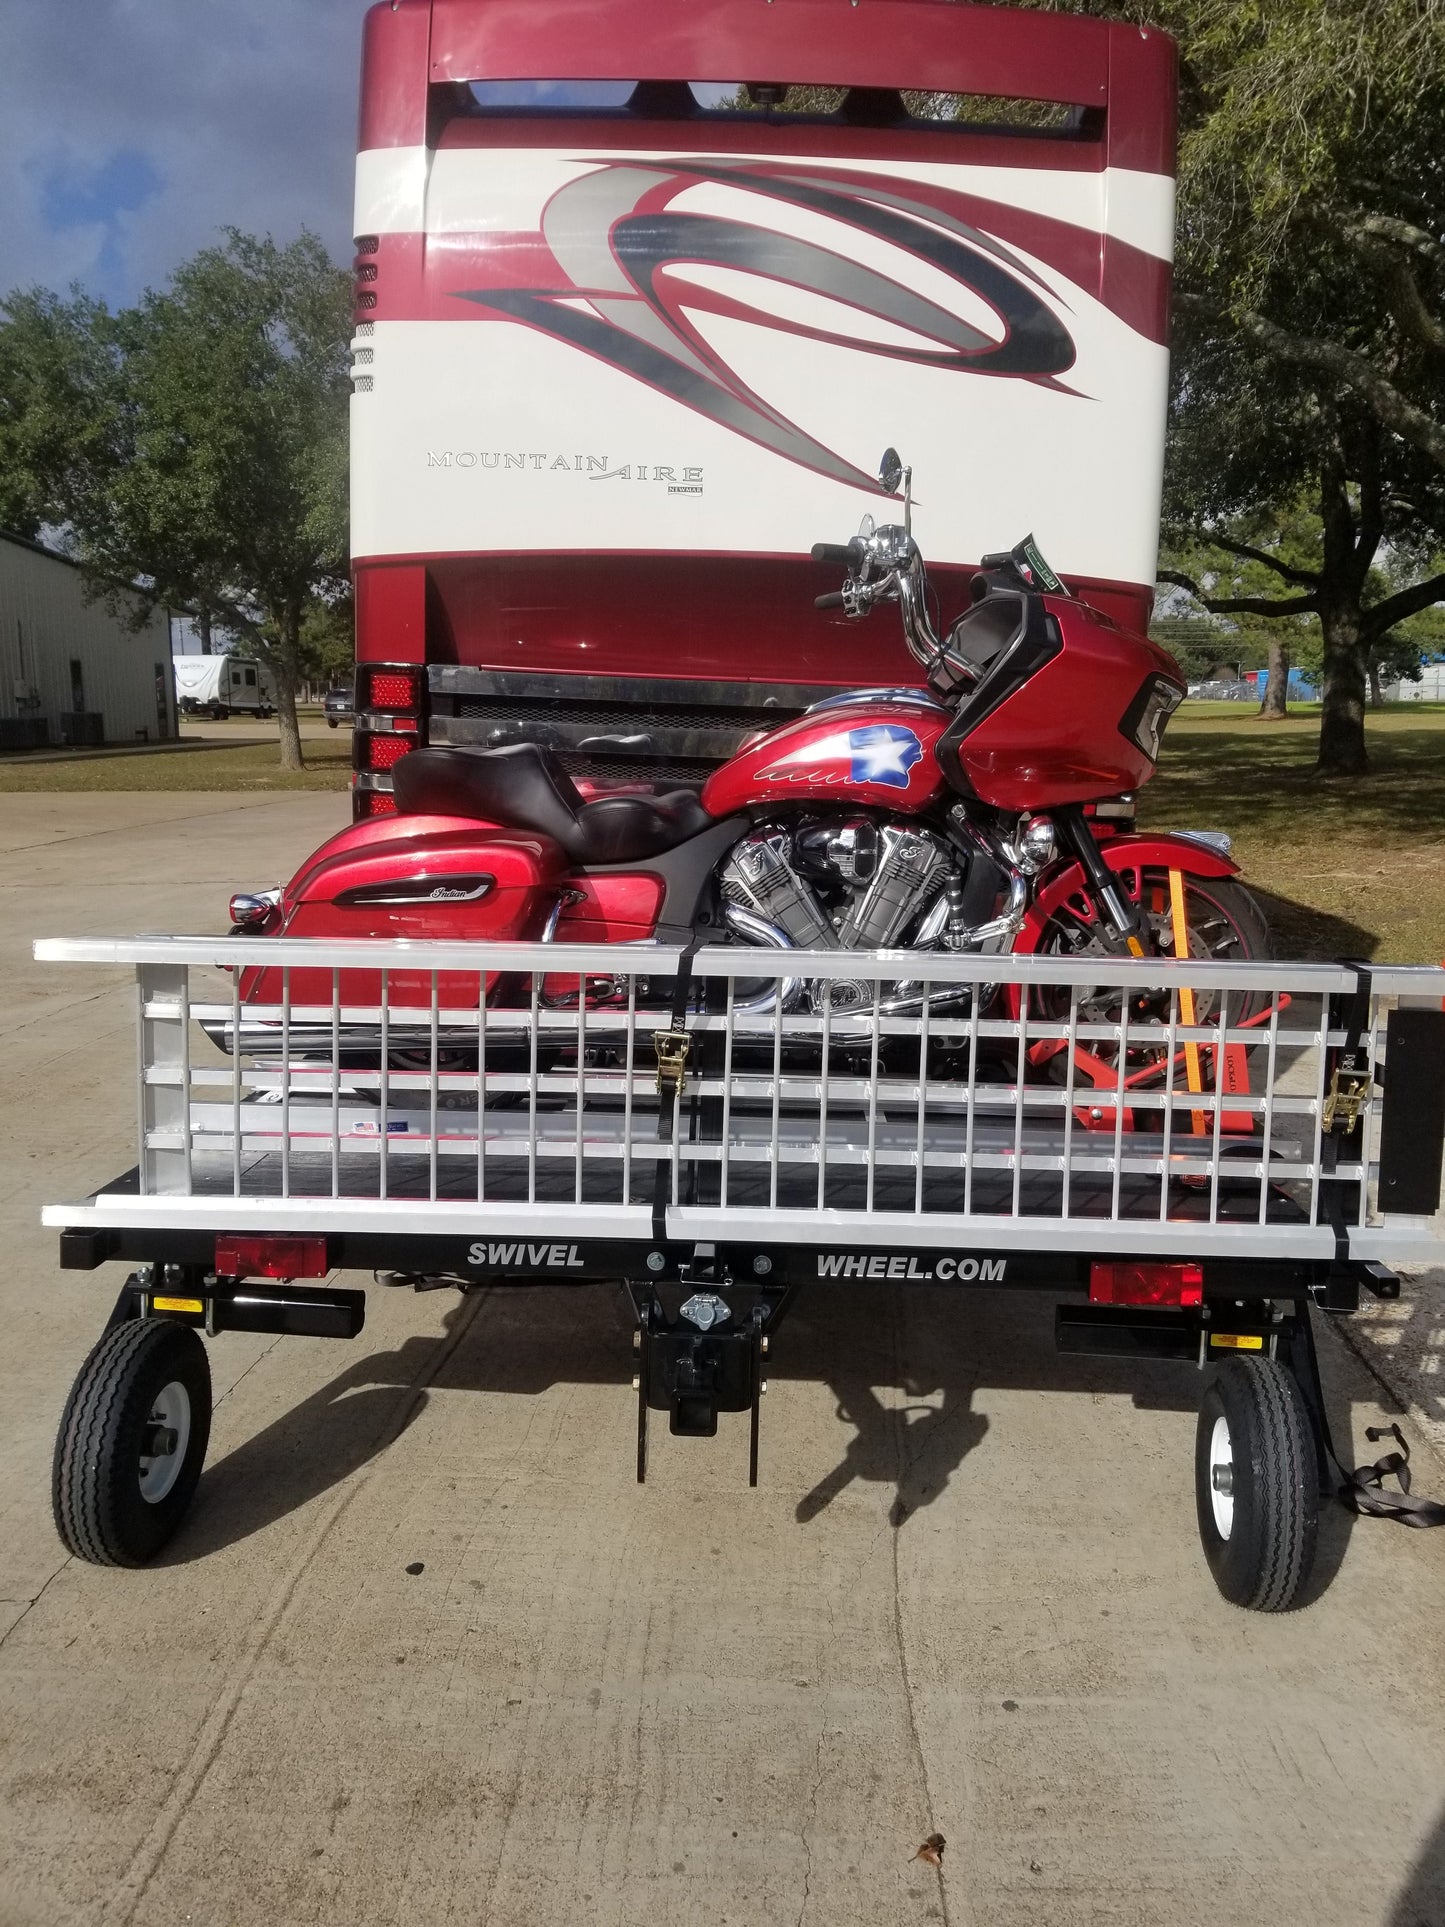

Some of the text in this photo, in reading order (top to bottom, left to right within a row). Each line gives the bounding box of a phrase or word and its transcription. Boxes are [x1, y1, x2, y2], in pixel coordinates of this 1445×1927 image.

[430, 887, 467, 899] Indian
[467, 1242, 1007, 1281] SWIVEL WHEEL.COM
